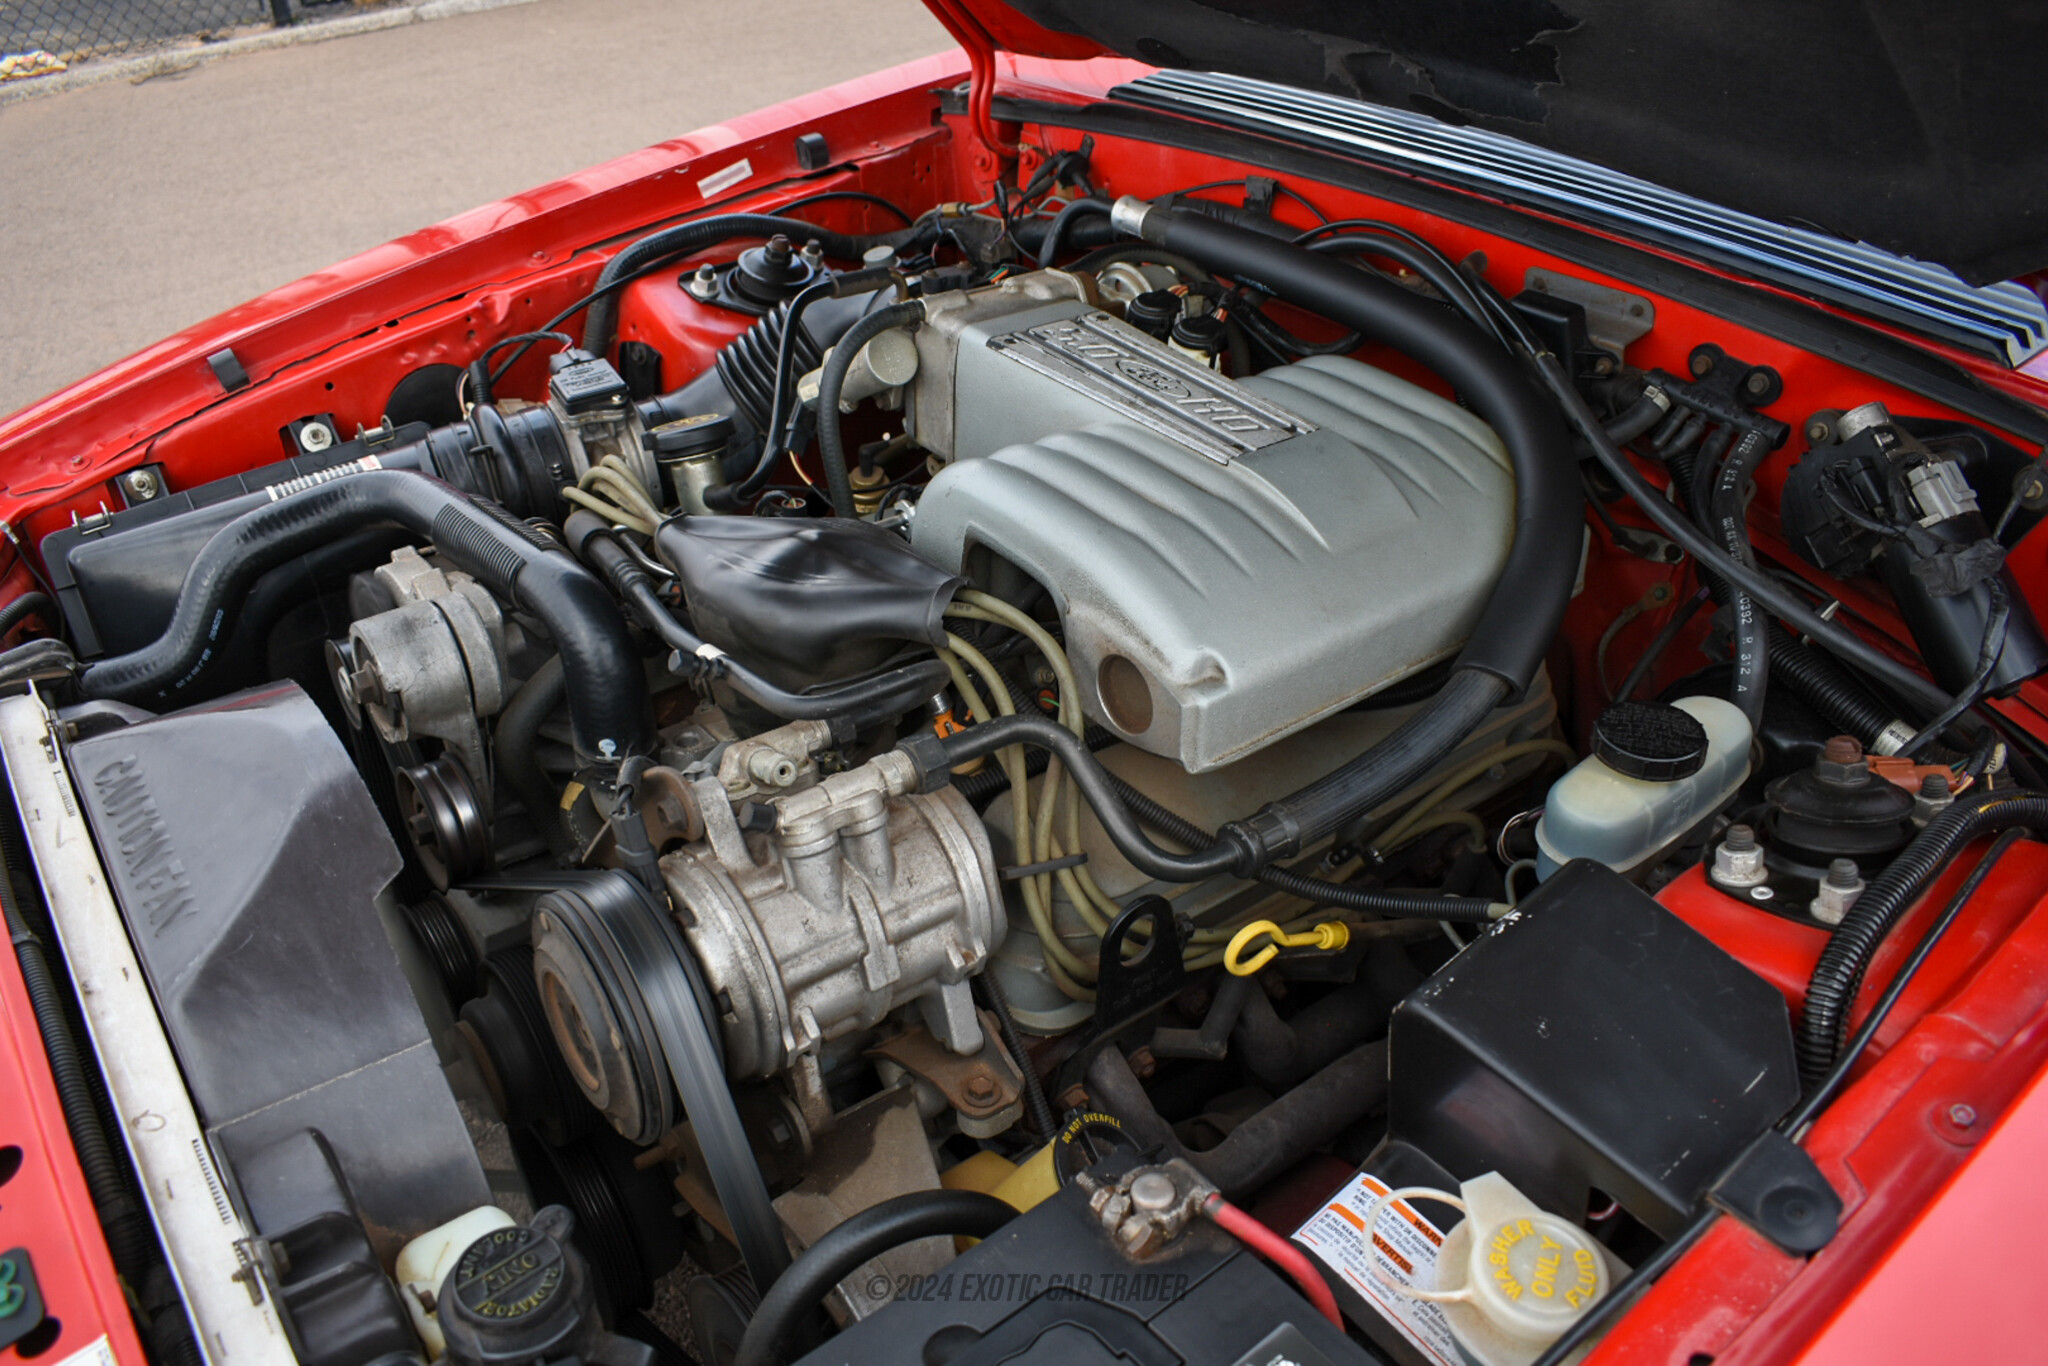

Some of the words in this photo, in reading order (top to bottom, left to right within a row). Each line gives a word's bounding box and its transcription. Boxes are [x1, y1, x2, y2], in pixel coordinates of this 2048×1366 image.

[1737, 684, 1748, 693] A
[94, 754, 174, 878] CAUTION
[136, 859, 200, 938] FAN
[1061, 1131, 1073, 1145] DO
[1068, 1117, 1083, 1134] NOT
[1083, 1112, 1121, 1129] OVERFILL
[1412, 1218, 1444, 1247] WARN
[481, 1251, 538, 1298] ONLY
[1488, 1219, 1536, 1301] WASHER
[1565, 1249, 1598, 1308] FLUID
[1531, 1235, 1563, 1298] ONLY
